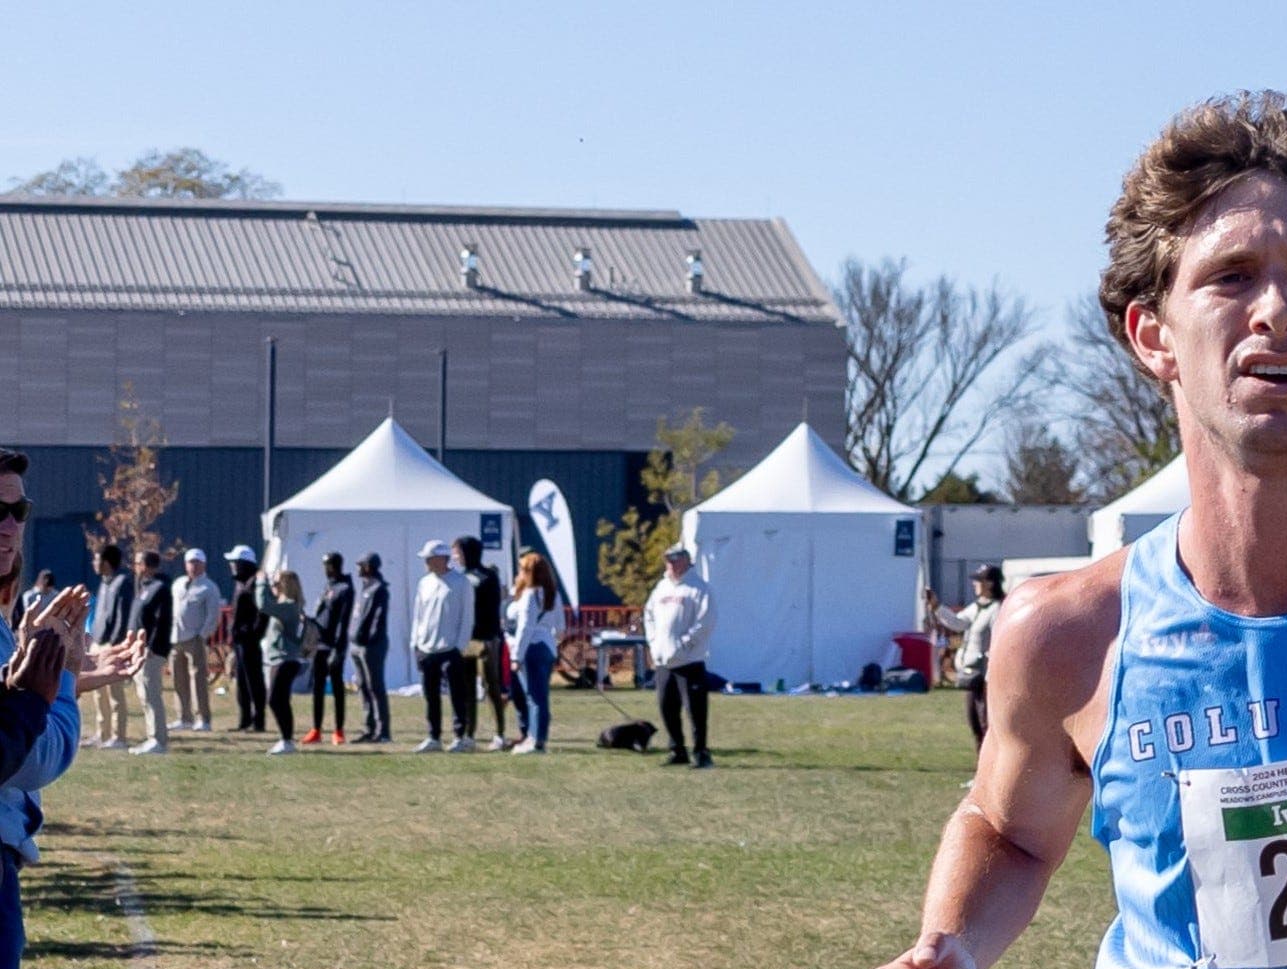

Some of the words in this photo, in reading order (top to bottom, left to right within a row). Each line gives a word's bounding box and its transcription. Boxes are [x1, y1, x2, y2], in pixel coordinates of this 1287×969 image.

[531, 491, 559, 533] Y
[1252, 769, 1276, 781] 2024
[1220, 784, 1251, 795] CROSS
[1256, 789, 1287, 801] CAMPUS
